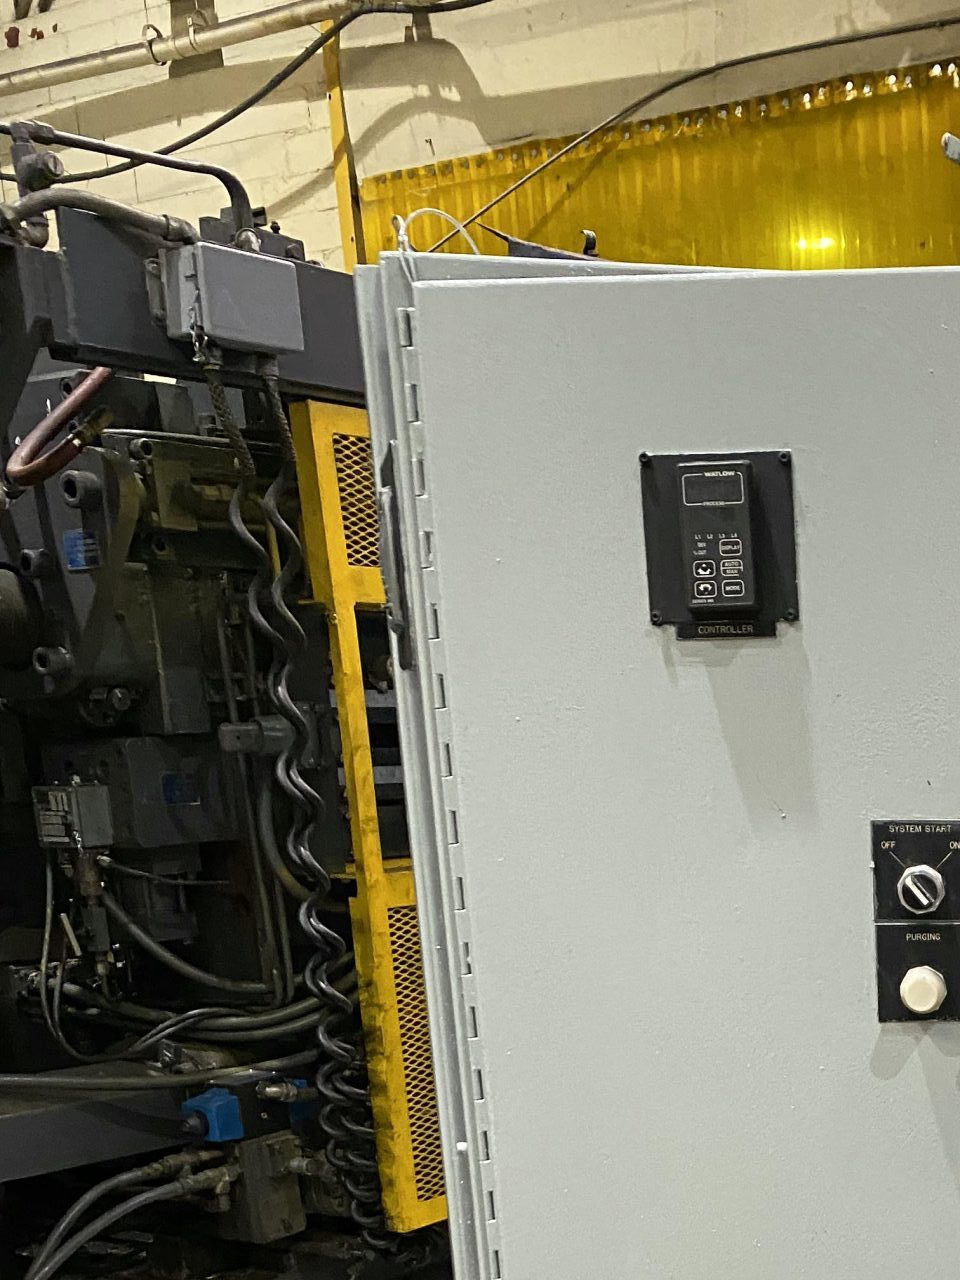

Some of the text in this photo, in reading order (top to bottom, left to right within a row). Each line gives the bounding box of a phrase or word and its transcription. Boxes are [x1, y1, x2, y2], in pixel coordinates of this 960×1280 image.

[697, 625, 754, 634] CONTROLLER
[889, 824, 952, 833] SYSTEM START
[881, 840, 960, 849] OFF ON
[906, 932, 941, 941] PURGING
